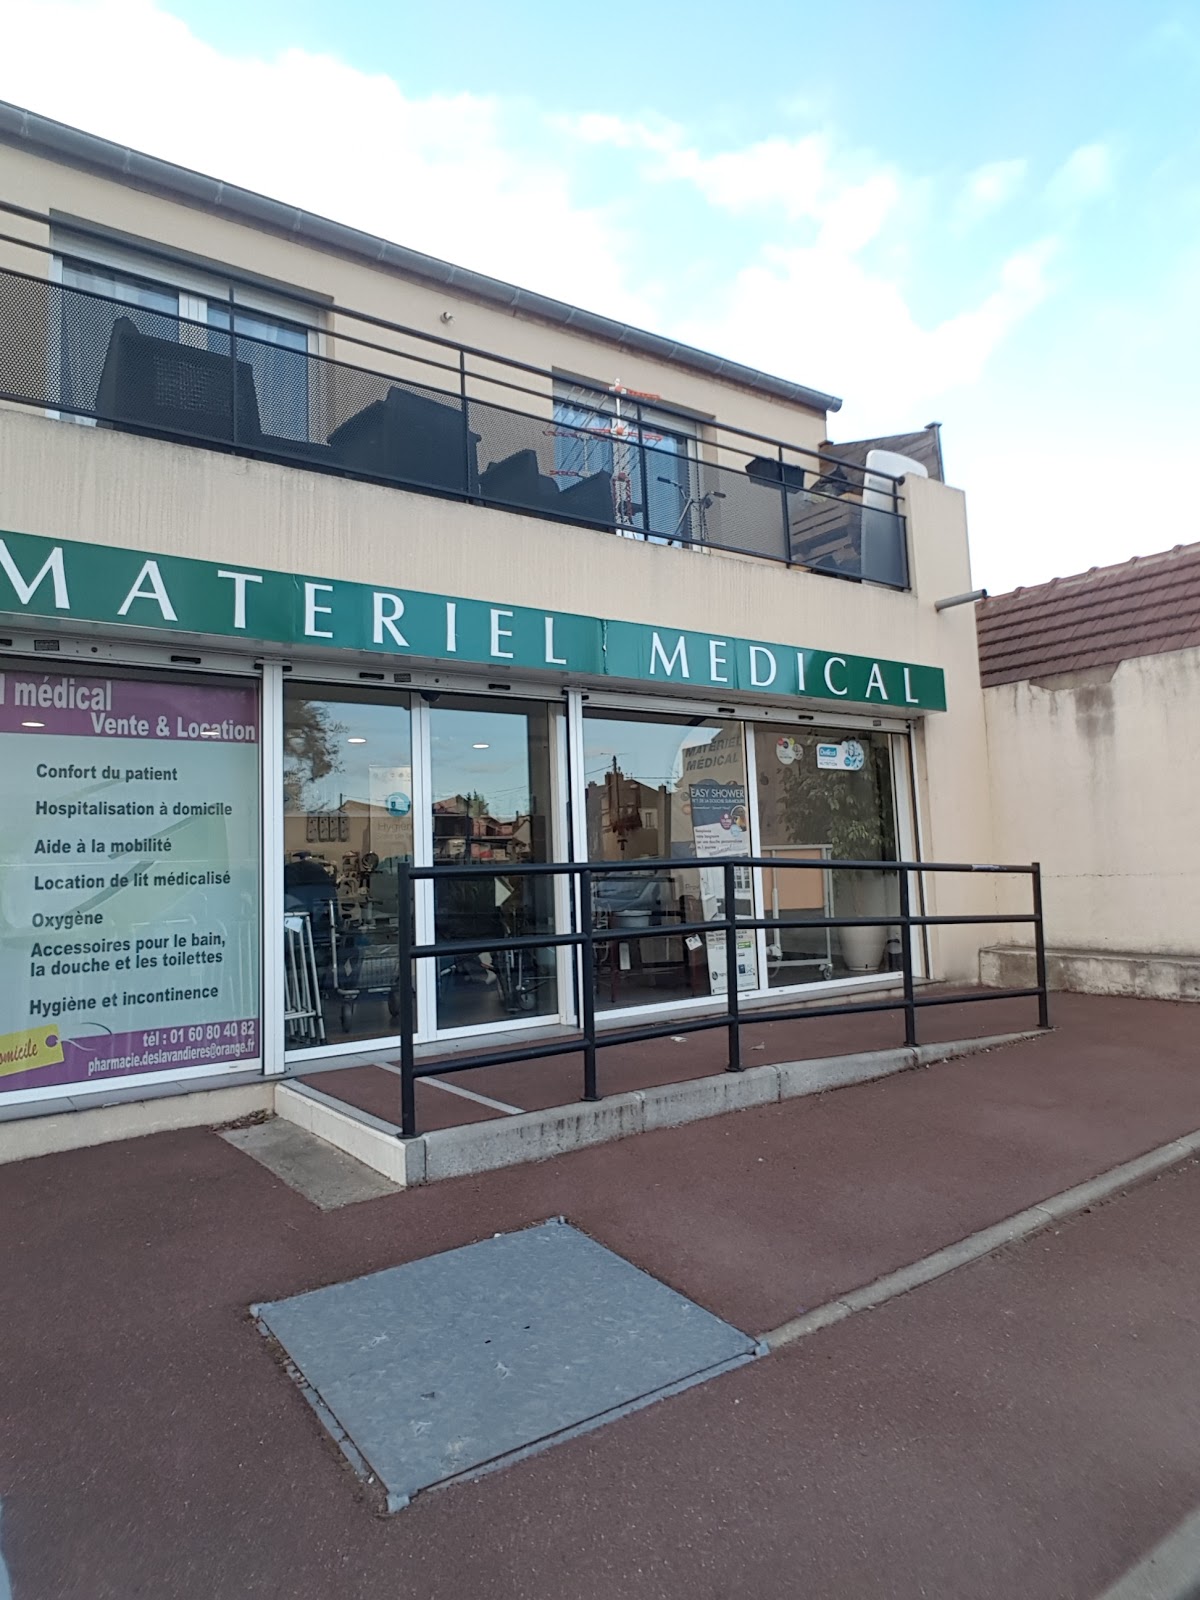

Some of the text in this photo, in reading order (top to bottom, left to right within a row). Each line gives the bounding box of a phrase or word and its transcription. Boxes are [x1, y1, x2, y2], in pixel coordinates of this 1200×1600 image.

[0, 539, 920, 705] MATERIEL MEDICAL
[14, 675, 113, 711] médical
[91, 712, 256, 741] Vente & Location
[36, 763, 178, 783] Confort du patient
[686, 752, 738, 771] MÉDICAL
[691, 787, 744, 798] EASY SHOWER
[35, 800, 232, 819] Hospitalisation à domicile
[34, 837, 172, 855] Aide à la mobilité
[34, 870, 231, 891] Location de lit médicalisé
[32, 910, 103, 930] Oxygène
[30, 931, 226, 957] Accessoires pour le bain,
[30, 951, 223, 977] la douche et les toilettes
[29, 985, 219, 1018] Hygiène et incontinence
[142, 1030, 159, 1047] tél
[170, 1028, 184, 1045] 01
[188, 1026, 203, 1042] 60
[206, 1024, 221, 1040] 80
[223, 1022, 238, 1039] 40
[240, 1020, 255, 1036] 82
[0, 1037, 38, 1065] omicile
[87, 1039, 256, 1075] pharmacie.deslavandieres@orange.fr
